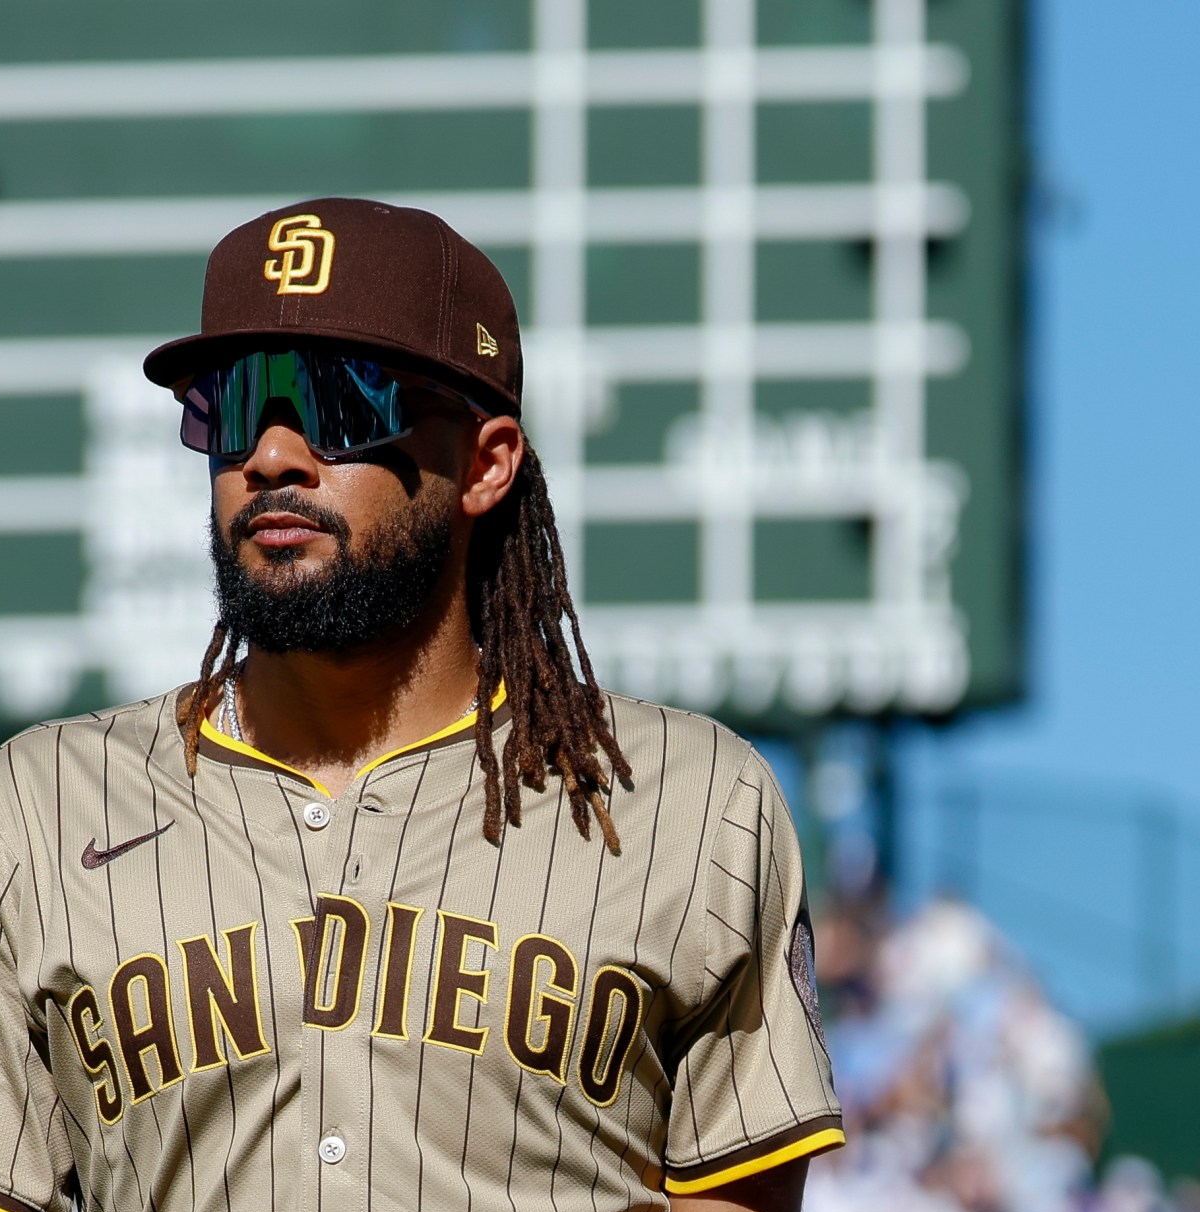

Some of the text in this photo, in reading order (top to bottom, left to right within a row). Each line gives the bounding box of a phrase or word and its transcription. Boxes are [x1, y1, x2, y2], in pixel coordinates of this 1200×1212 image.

[264, 213, 335, 295] SD
[69, 892, 643, 1126] SAN DIEGO
